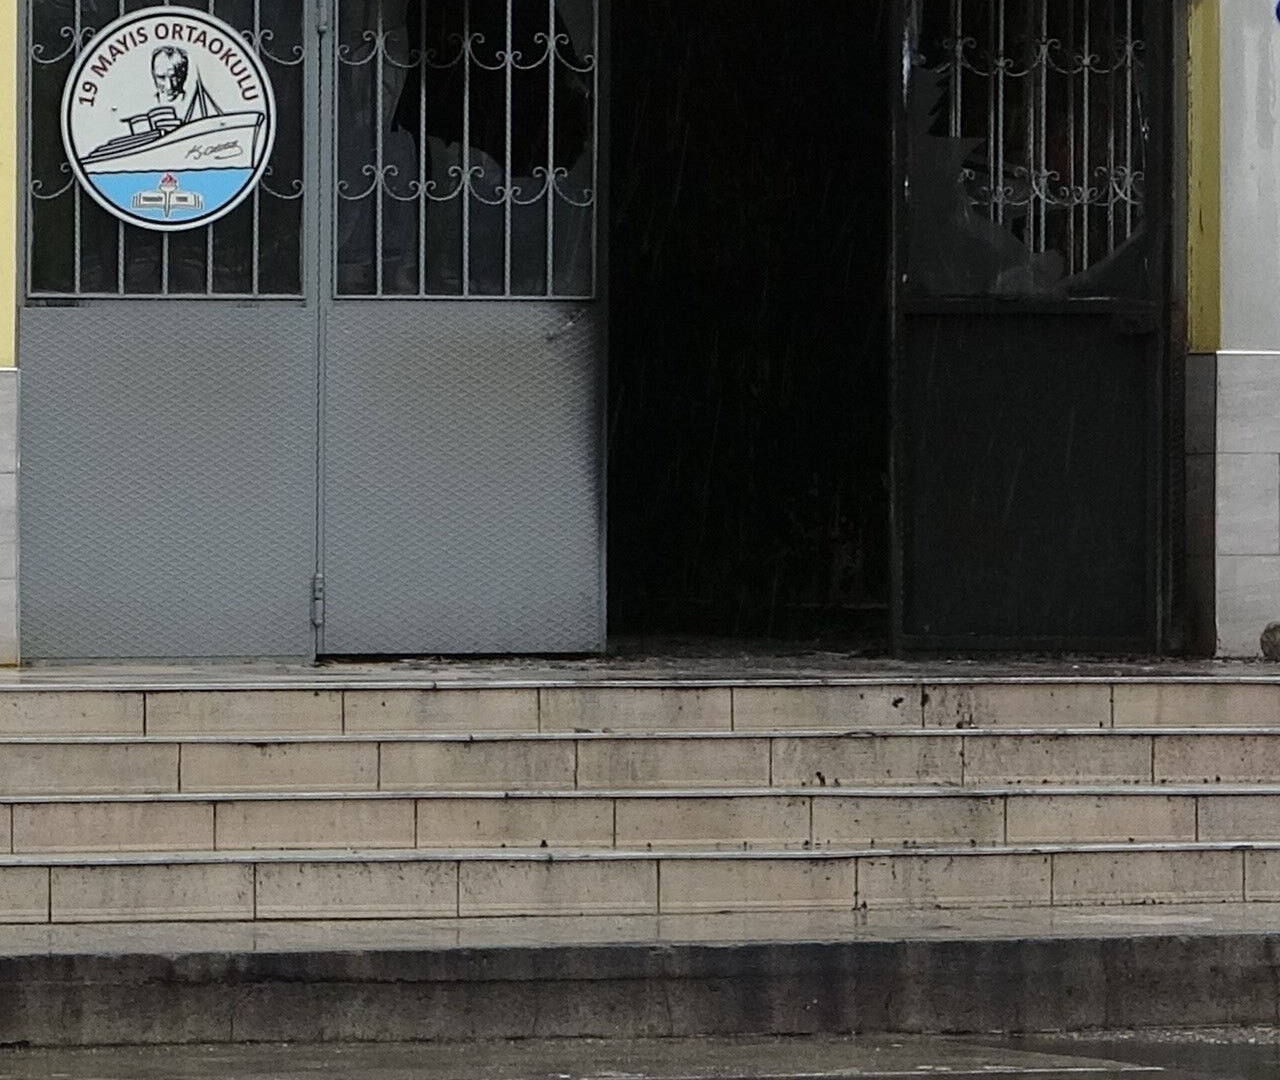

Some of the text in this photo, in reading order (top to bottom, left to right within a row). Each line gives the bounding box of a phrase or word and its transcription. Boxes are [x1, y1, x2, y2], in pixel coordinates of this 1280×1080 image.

[78, 23, 259, 108] 19 MAYIS ORTAOKULU
